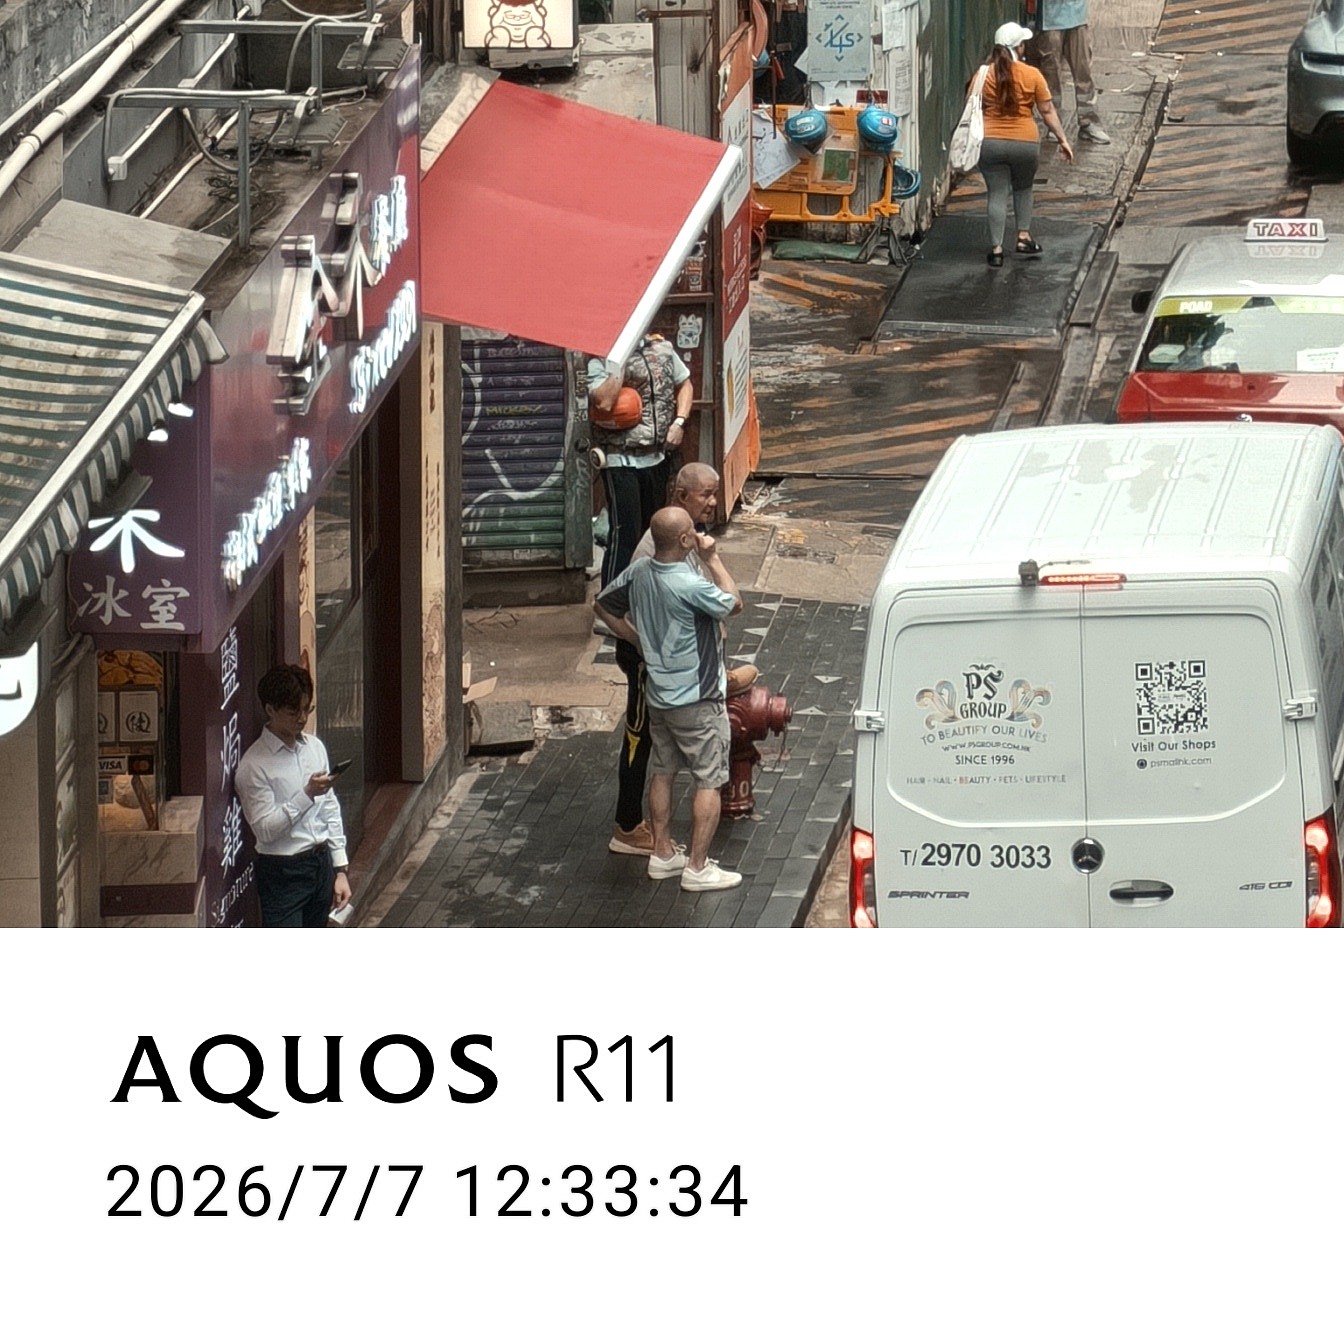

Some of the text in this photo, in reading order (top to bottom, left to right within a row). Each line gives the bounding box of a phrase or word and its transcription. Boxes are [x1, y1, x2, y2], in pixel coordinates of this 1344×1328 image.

[1253, 222, 1319, 237] TAXI
[77, 575, 190, 632] 冰室
[962, 669, 1005, 701] PS
[959, 702, 1007, 719] GROUP
[920, 725, 1048, 746] TO BEAUTIFY OUR LIVES
[1131, 739, 1216, 753] Visit Our Shops
[99, 760, 123, 771] VISA
[955, 754, 1015, 765] SINCE 1996
[959, 776, 991, 784] BEAUTY
[921, 842, 982, 867] 2970
[989, 844, 1052, 869] 3033
[888, 890, 970, 899] SPRINTER
